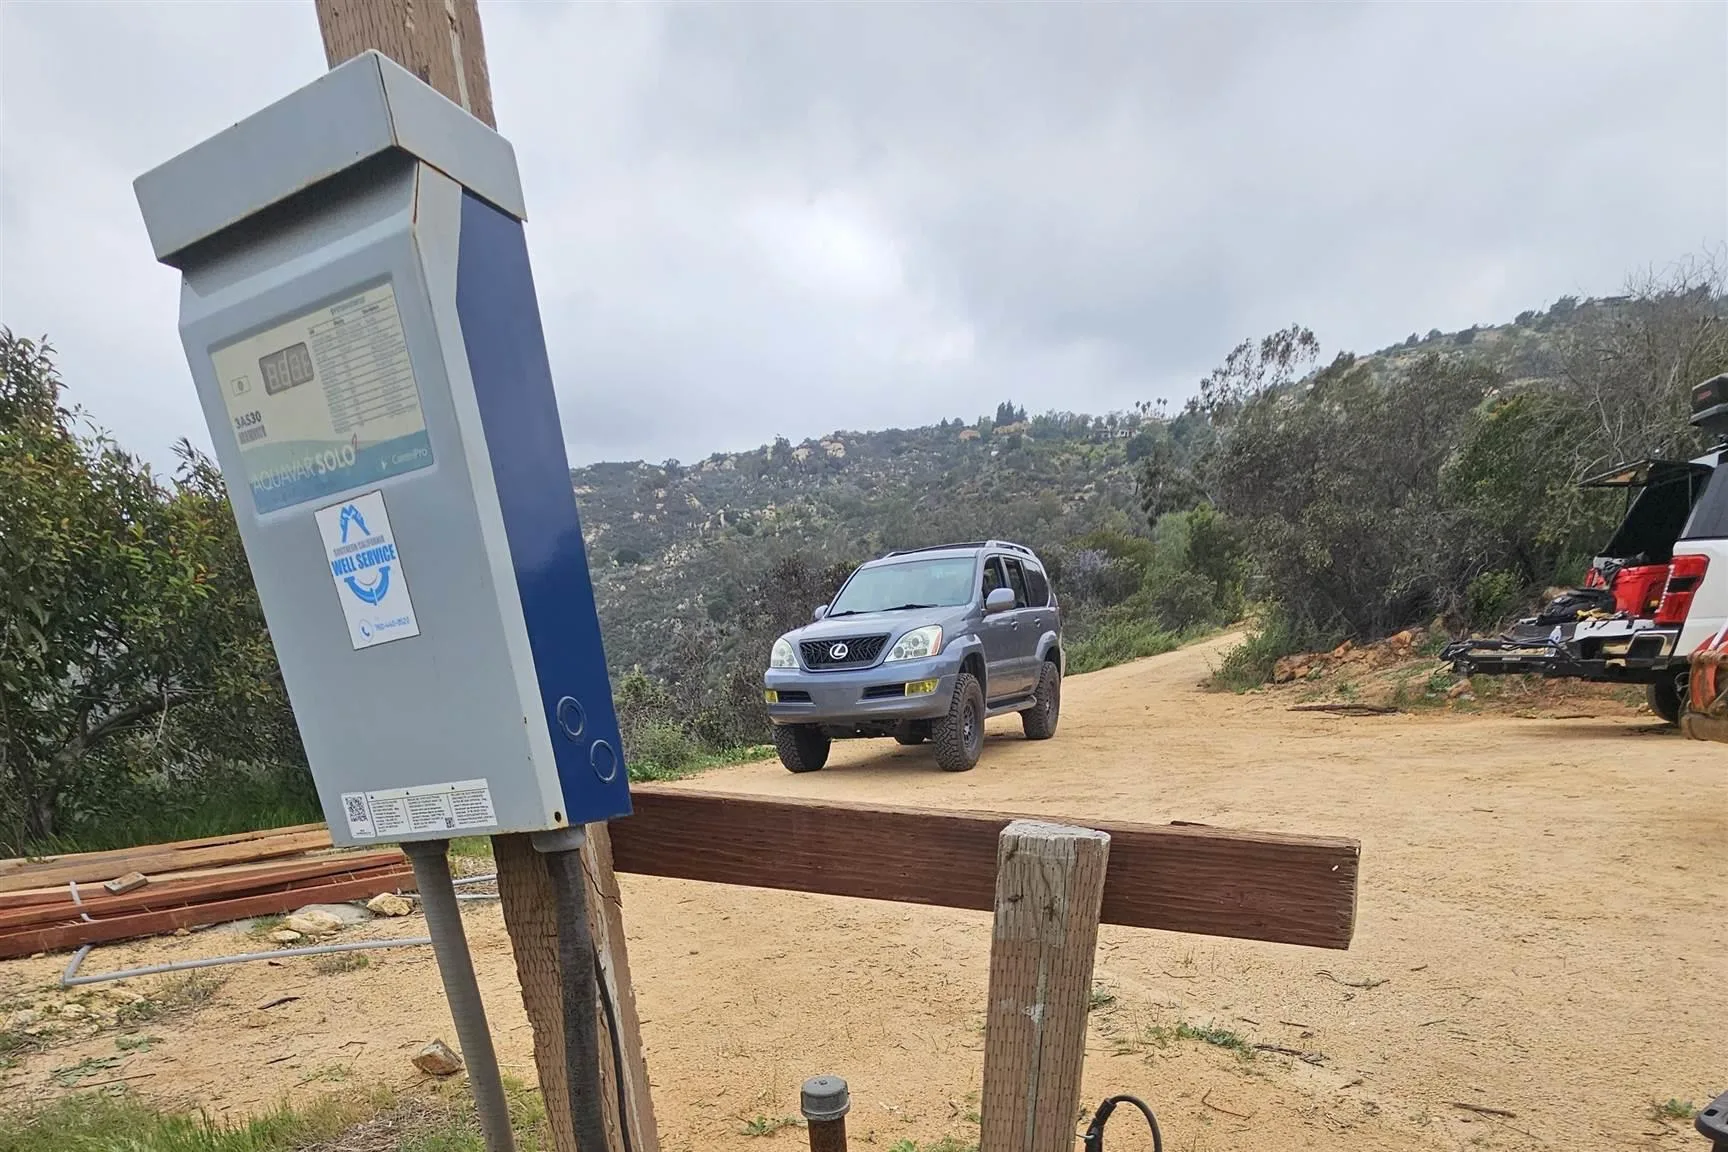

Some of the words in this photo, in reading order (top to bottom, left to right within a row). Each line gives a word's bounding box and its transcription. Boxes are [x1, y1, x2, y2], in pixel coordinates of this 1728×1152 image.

[234, 410, 262, 429] 3AS30
[252, 456, 317, 494] AQUAVAR
[331, 556, 357, 576] WELL
[355, 543, 396, 570] SERVICE
